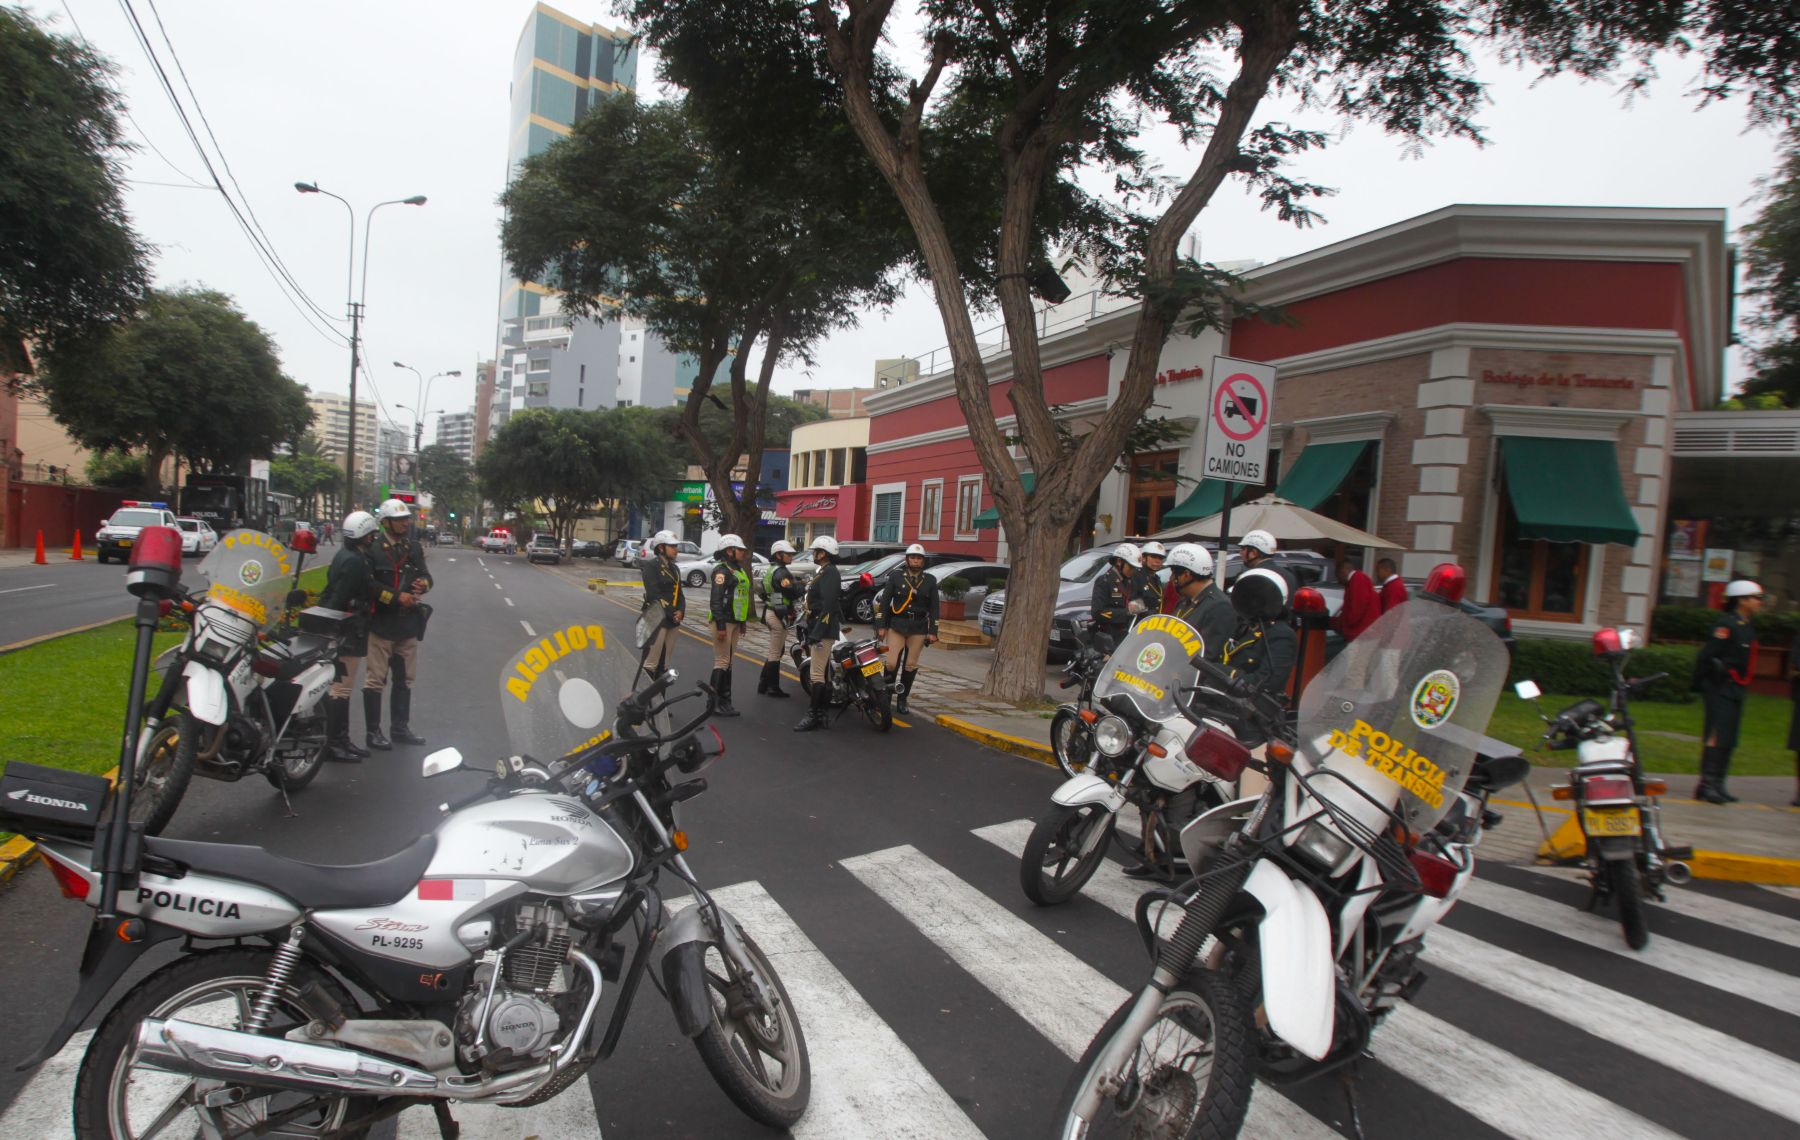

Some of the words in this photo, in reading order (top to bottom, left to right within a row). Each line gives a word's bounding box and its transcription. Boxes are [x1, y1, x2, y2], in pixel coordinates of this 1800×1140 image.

[1482, 369, 1535, 389] Bodega
[1537, 372, 1553, 386] de
[1557, 373, 1570, 386] la
[1572, 373, 1635, 389] Trattoria
[1226, 442, 1246, 458] NO
[1208, 457, 1260, 478] CAMIONES
[224, 531, 291, 575] POLICIA
[1136, 616, 1202, 657] POLICIA
[1113, 669, 1165, 700] TRANSITO
[1347, 719, 1447, 790] POLICIA
[1327, 729, 1363, 757] DE
[1364, 747, 1445, 810] TRANSITO
[25, 793, 88, 811] HONDA
[550, 815, 593, 828] HONDA
[136, 887, 241, 920] POLICIA
[354, 917, 429, 932] Storm
[501, 1021, 536, 1032] HONDA
